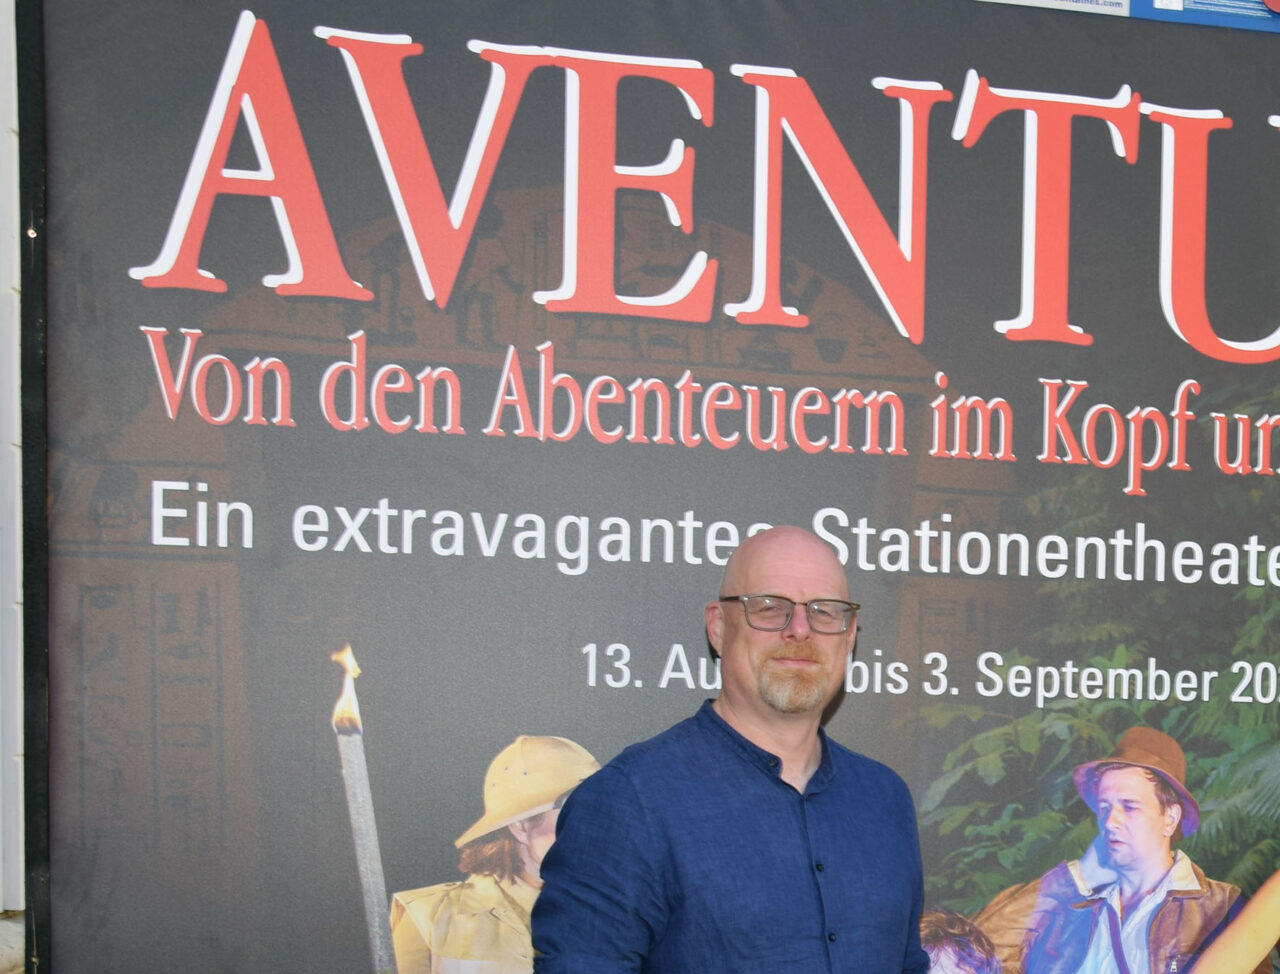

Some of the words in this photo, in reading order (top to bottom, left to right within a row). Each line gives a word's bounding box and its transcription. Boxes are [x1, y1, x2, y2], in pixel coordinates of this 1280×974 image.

[139, 326, 295, 427] Von
[319, 329, 466, 435] den
[482, 341, 907, 456] Abenteuern
[928, 371, 1017, 463] im
[1036, 377, 1201, 497] Kopf
[150, 480, 254, 549] Ein
[581, 642, 643, 689] 13.
[845, 649, 909, 695] bis
[922, 651, 959, 697] 3.
[976, 651, 1219, 709] September
